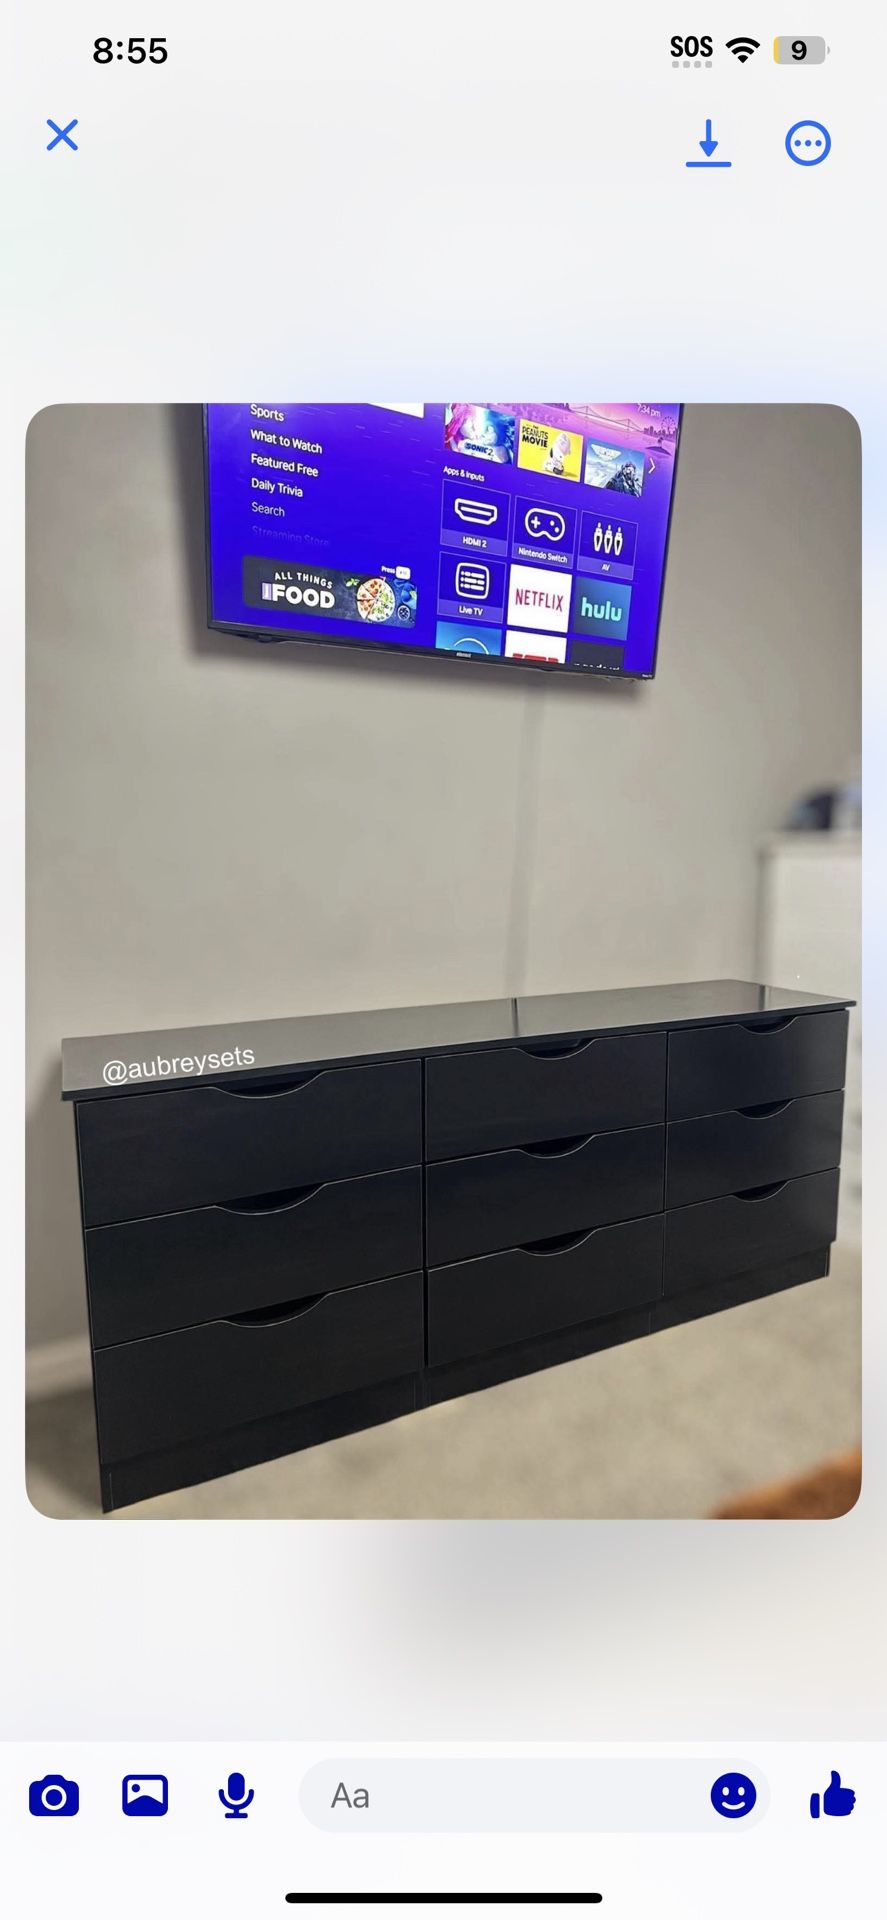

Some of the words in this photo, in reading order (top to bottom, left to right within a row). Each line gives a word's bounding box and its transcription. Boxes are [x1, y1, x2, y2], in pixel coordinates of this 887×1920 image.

[250, 403, 285, 421] Sports
[522, 426, 549, 439] PEANUTS
[250, 429, 277, 444] What
[279, 435, 291, 448] to
[292, 438, 323, 454] Watch
[465, 442, 488, 454] SONIC
[488, 448, 494, 456] 2
[522, 434, 548, 448] MOVIE
[251, 453, 295, 472] Featured
[297, 464, 319, 477] Free
[443, 466, 459, 477] Apps
[460, 469, 465, 478] &
[251, 477, 276, 494] Daily
[277, 482, 303, 497] Trivia
[251, 502, 285, 517] Search
[463, 536, 481, 547] HDMI
[482, 538, 487, 548] 2
[518, 546, 547, 561] Nintendo
[547, 552, 568, 564] Switch
[602, 563, 611, 572] AV
[274, 571, 293, 581] ALL
[296, 571, 333, 589] THINGS
[515, 588, 564, 613] NETFLIX
[459, 605, 471, 615] Live
[471, 608, 483, 617] TV
[581, 597, 622, 621] hulu
